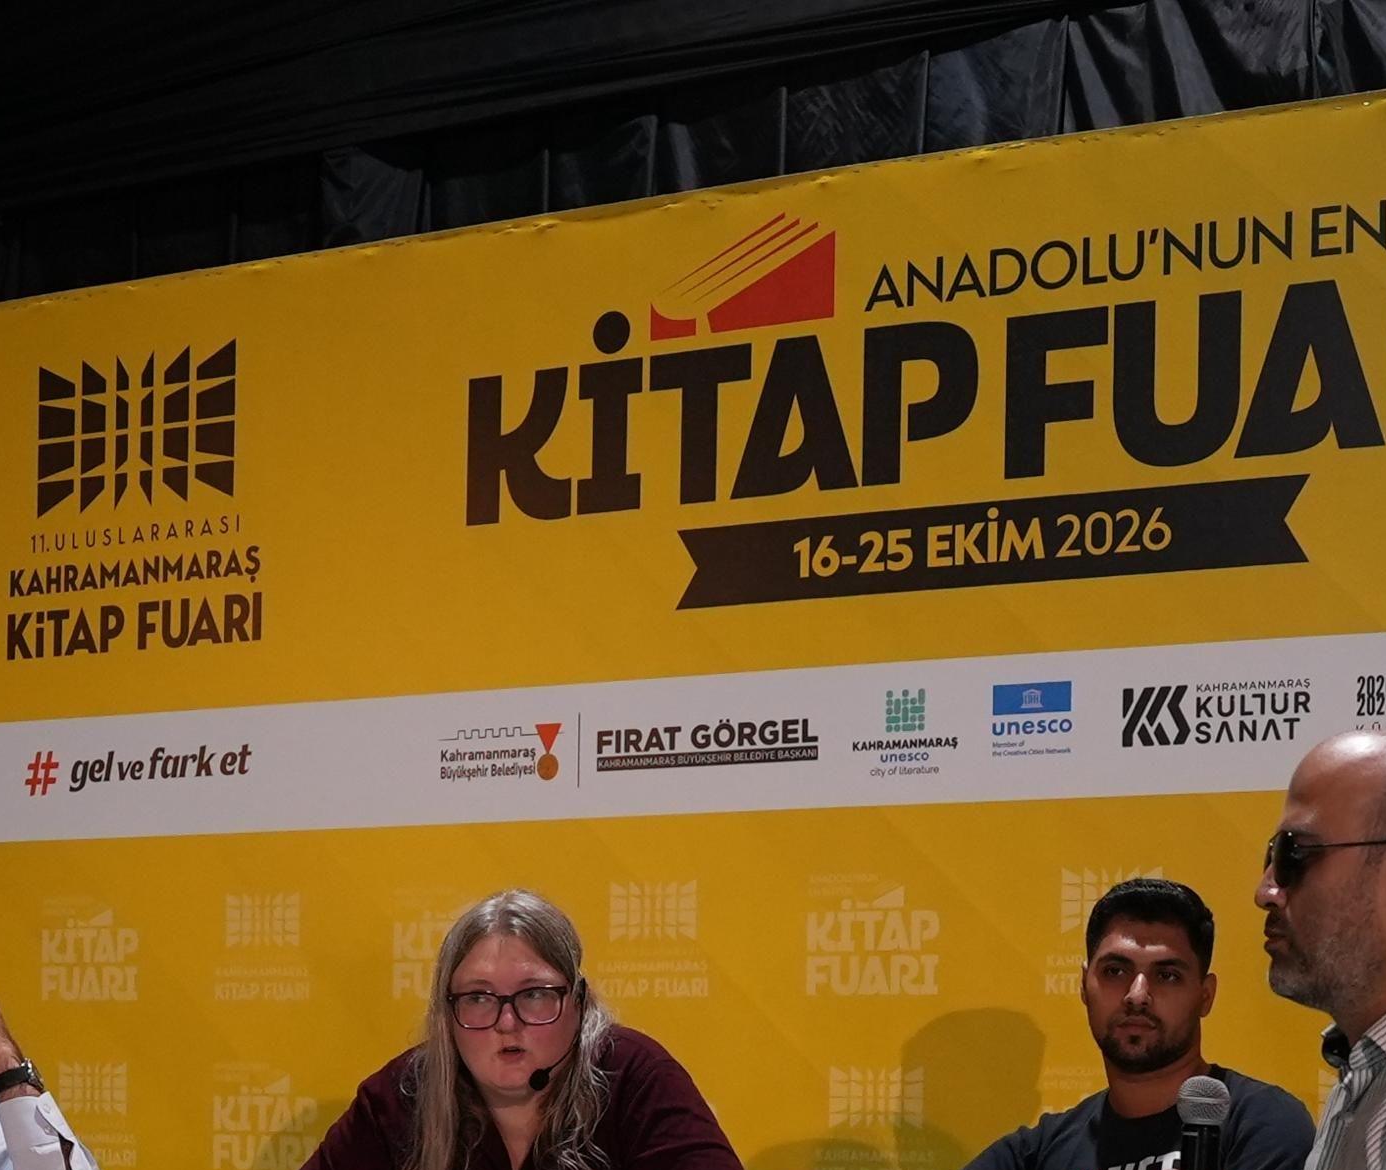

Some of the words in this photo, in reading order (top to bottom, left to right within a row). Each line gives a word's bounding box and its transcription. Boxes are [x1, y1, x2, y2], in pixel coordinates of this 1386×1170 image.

[863, 208, 1295, 314] ANADOLU'NUN
[465, 309, 979, 528] KİTAP
[793, 528, 915, 581] 16-25
[924, 504, 1045, 571] EKİM
[1054, 506, 1174, 560] 2026
[9, 545, 261, 598] KAHRAMANMARAŞ
[137, 591, 263, 652] FUARI
[1196, 678, 1311, 693] KAHRAMANMARAŞ
[597, 727, 682, 754] FIRAT
[691, 718, 819, 750] GÖRGEL
[992, 718, 1073, 736] unesco
[1195, 718, 1300, 744] SANAT
[440, 747, 536, 764] Kahramanmaraş
[852, 737, 958, 752] KAHRAMANMARAŞ
[880, 751, 929, 764] unesco
[69, 750, 116, 793] gel
[117, 758, 144, 782] ve
[148, 746, 217, 781] fark
[219, 743, 253, 777] et
[440, 764, 489, 782] Büyükşehir
[491, 762, 536, 778] Belediyesi
[870, 767, 886, 778] city
[888, 766, 897, 776] of
[899, 766, 940, 775] literature
[806, 954, 940, 996] FUARI
